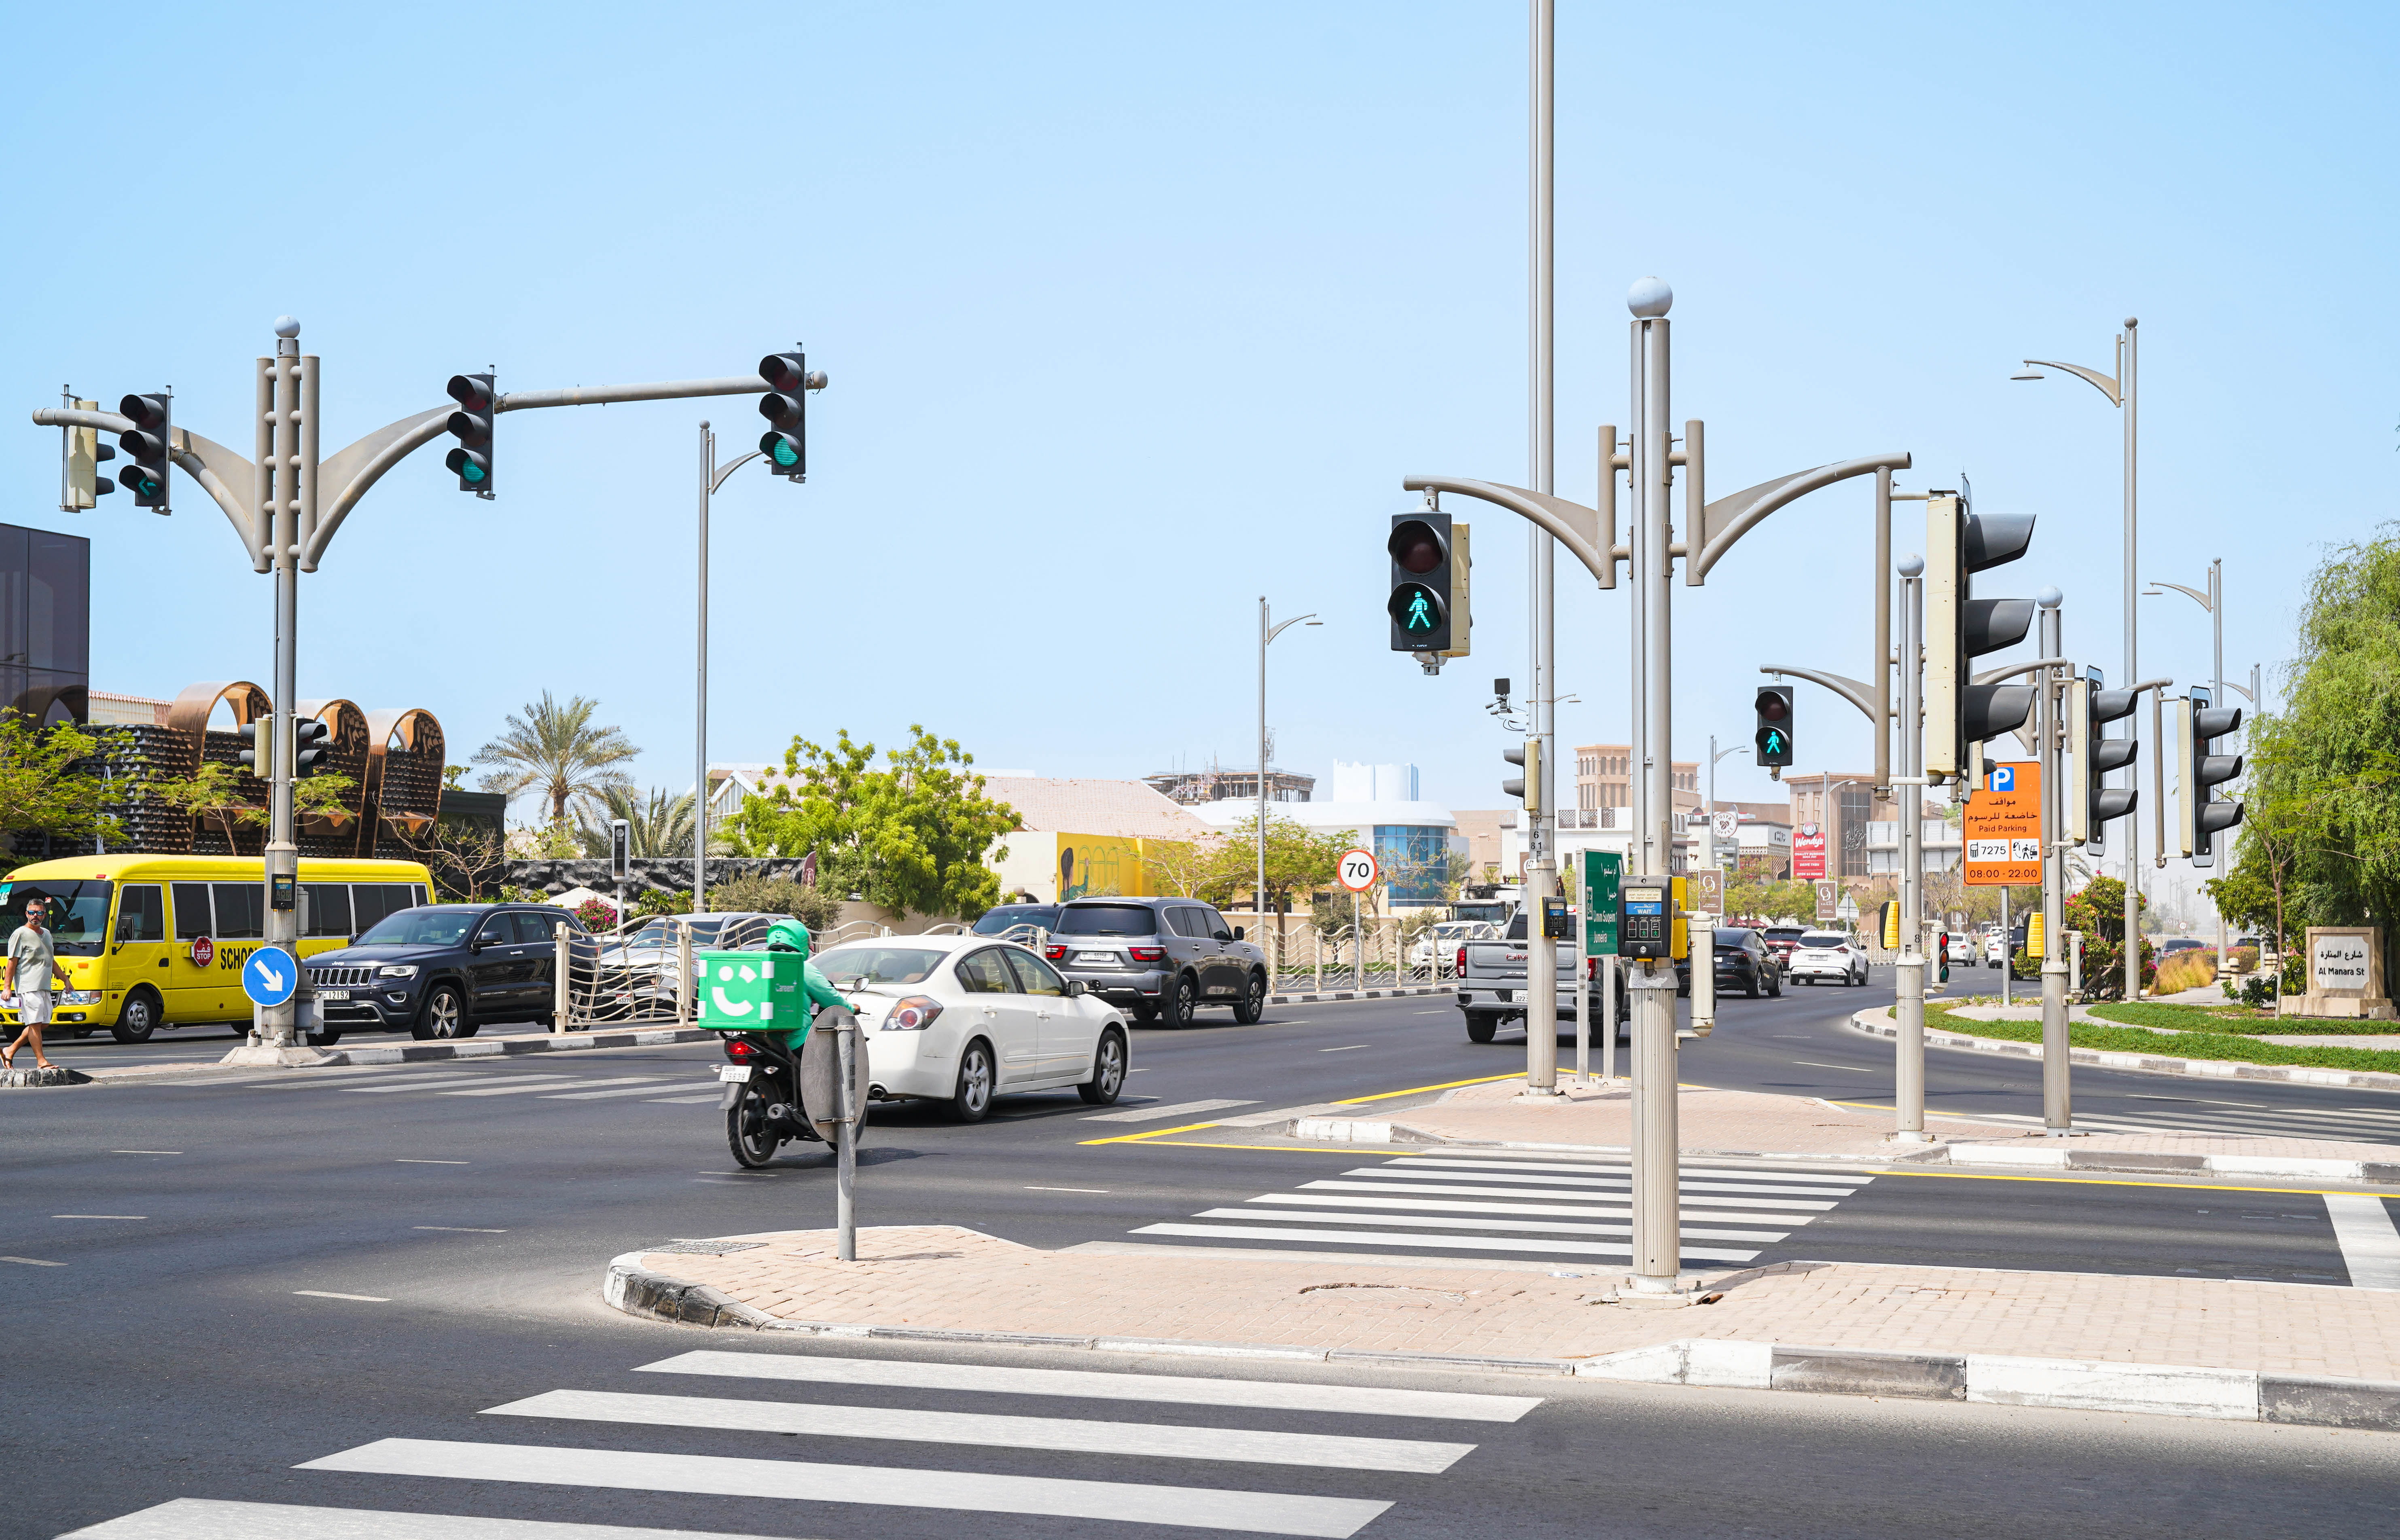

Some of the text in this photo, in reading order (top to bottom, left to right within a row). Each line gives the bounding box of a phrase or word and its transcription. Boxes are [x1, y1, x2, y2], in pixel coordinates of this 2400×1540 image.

[1993, 768, 2011, 791] P
[1989, 797, 2016, 807] مواقف
[1968, 811, 2038, 824] خاضعة للرسوم
[1795, 836, 1824, 848] Wendy's
[1981, 846, 2006, 855] 7275
[1346, 863, 1369, 878] 70
[1970, 870, 2000, 878] 08:00
[2008, 869, 2038, 878] 22:00
[1593, 910, 1603, 922] Umm
[1602, 910, 1616, 925] Suqeim
[1593, 930, 1607, 943] Jumeira
[1915, 934, 1920, 943] 8
[197, 943, 211, 952] قف
[220, 947, 258, 970] SCHO
[1506, 953, 1528, 961] GM
[2320, 950, 2363, 961] شارع المنارة
[2318, 967, 2364, 976] Al Manara St
[329, 991, 349, 999] 12192
